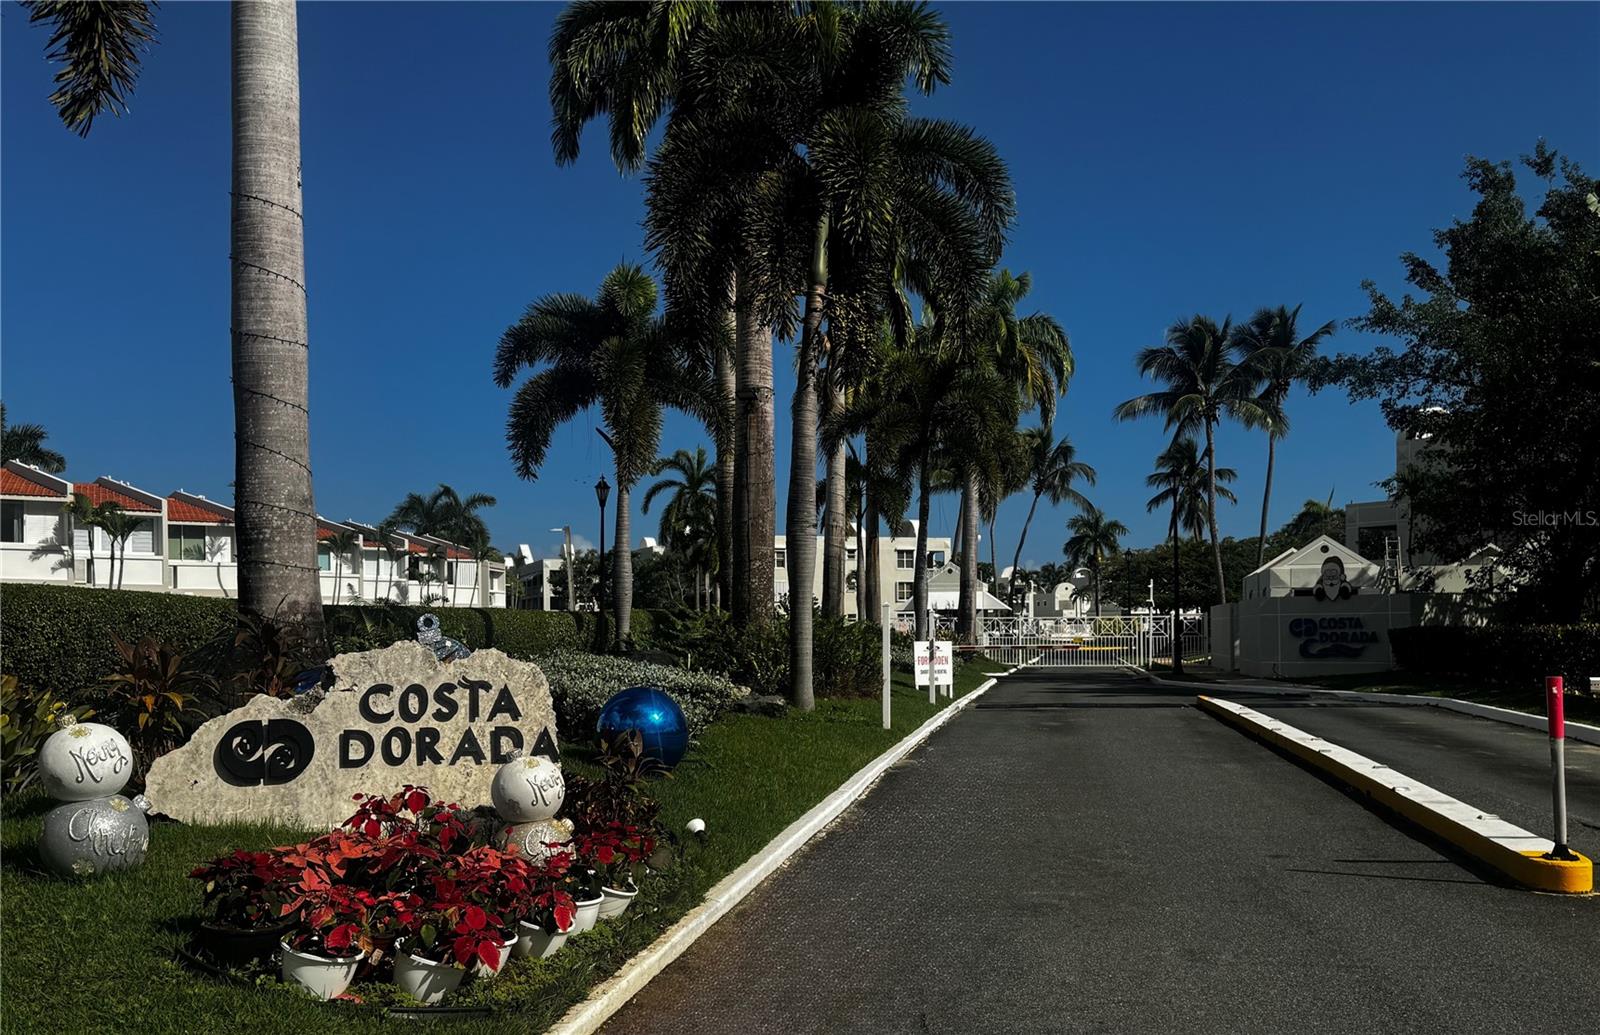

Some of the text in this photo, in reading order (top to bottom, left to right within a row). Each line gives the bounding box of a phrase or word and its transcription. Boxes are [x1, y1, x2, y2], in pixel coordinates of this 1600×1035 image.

[1318, 617, 1364, 630] COSTA
[1319, 631, 1379, 643] DORADA
[917, 655, 949, 665] FORDDEN
[358, 675, 523, 724] COSTA
[338, 725, 560, 769] DORADA
